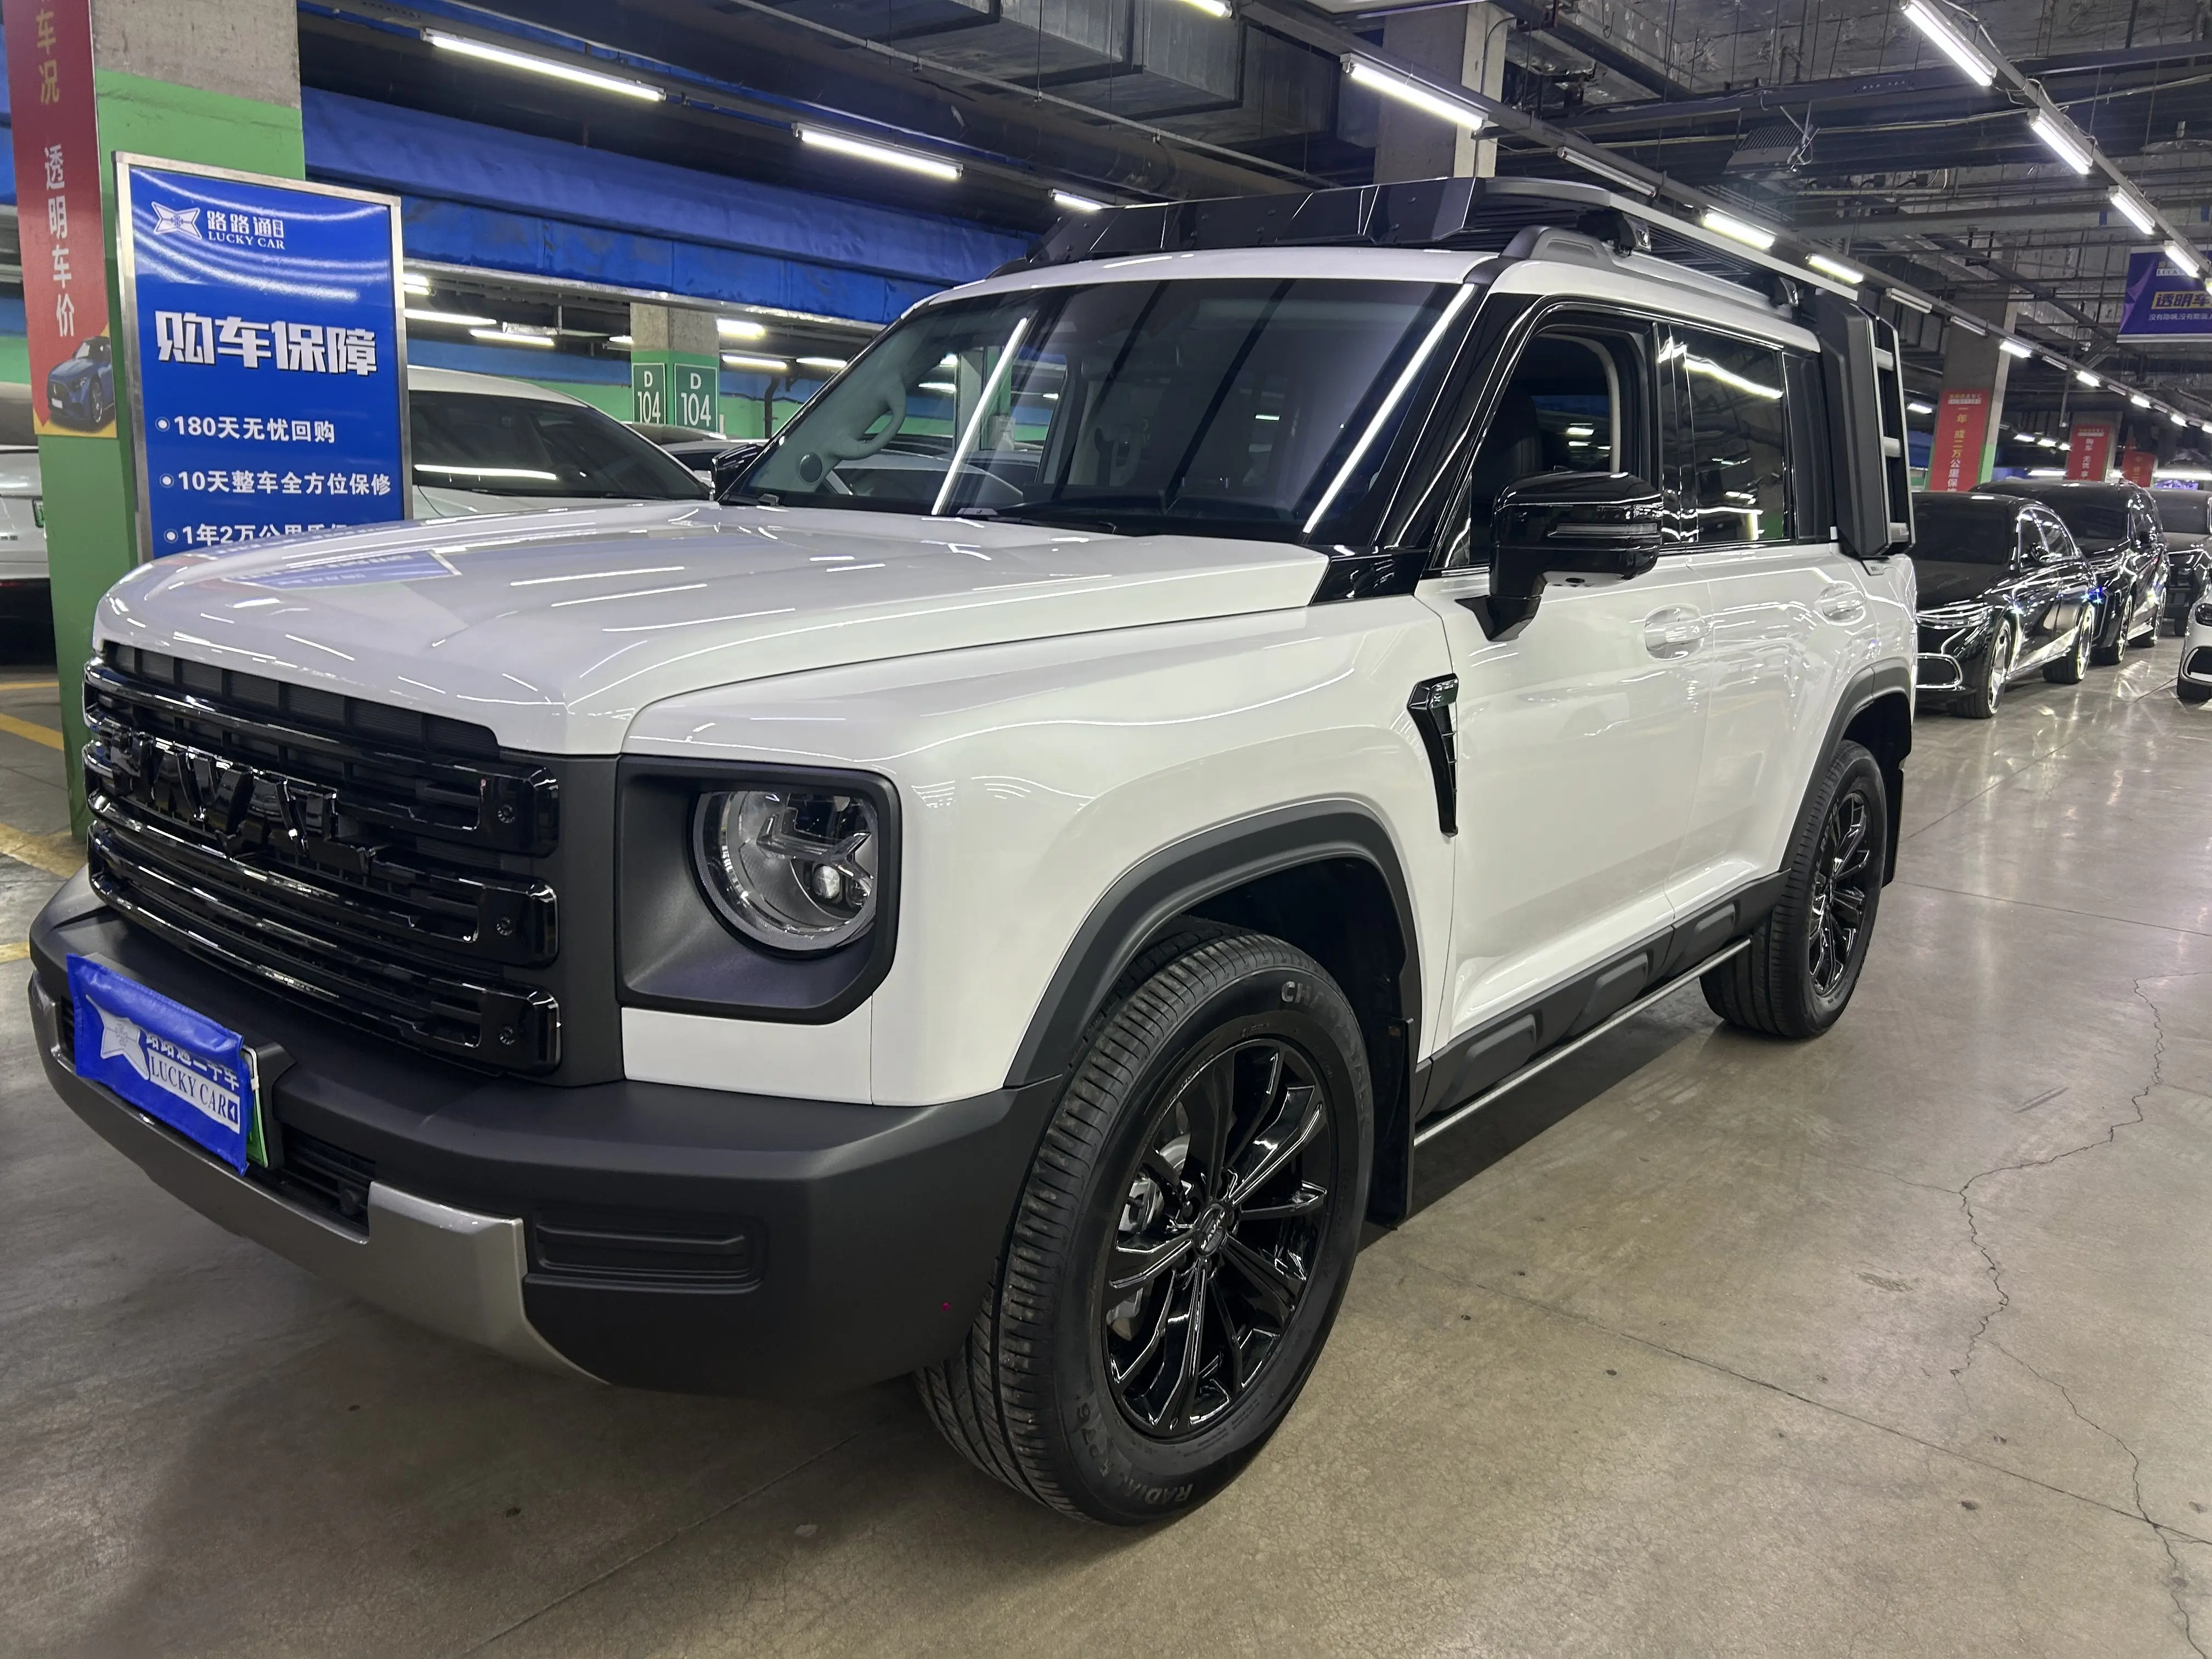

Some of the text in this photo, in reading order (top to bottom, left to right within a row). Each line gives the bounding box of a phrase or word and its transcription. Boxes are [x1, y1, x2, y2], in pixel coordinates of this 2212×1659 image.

[36, 0, 74, 337] 车况 透明车价
[207, 211, 272, 237] 路路通
[208, 231, 285, 250] LUCKY CAR
[2155, 293, 2212, 307] 透明车
[155, 311, 377, 376] 购车保障
[644, 371, 653, 387] D
[690, 373, 701, 390] D
[637, 391, 661, 424] 104
[681, 392, 712, 427] 104
[174, 415, 335, 443] 180天无忧回购
[178, 470, 392, 496] 10天整车全方位保修
[151, 1056, 228, 1119] LUCKY CAR
